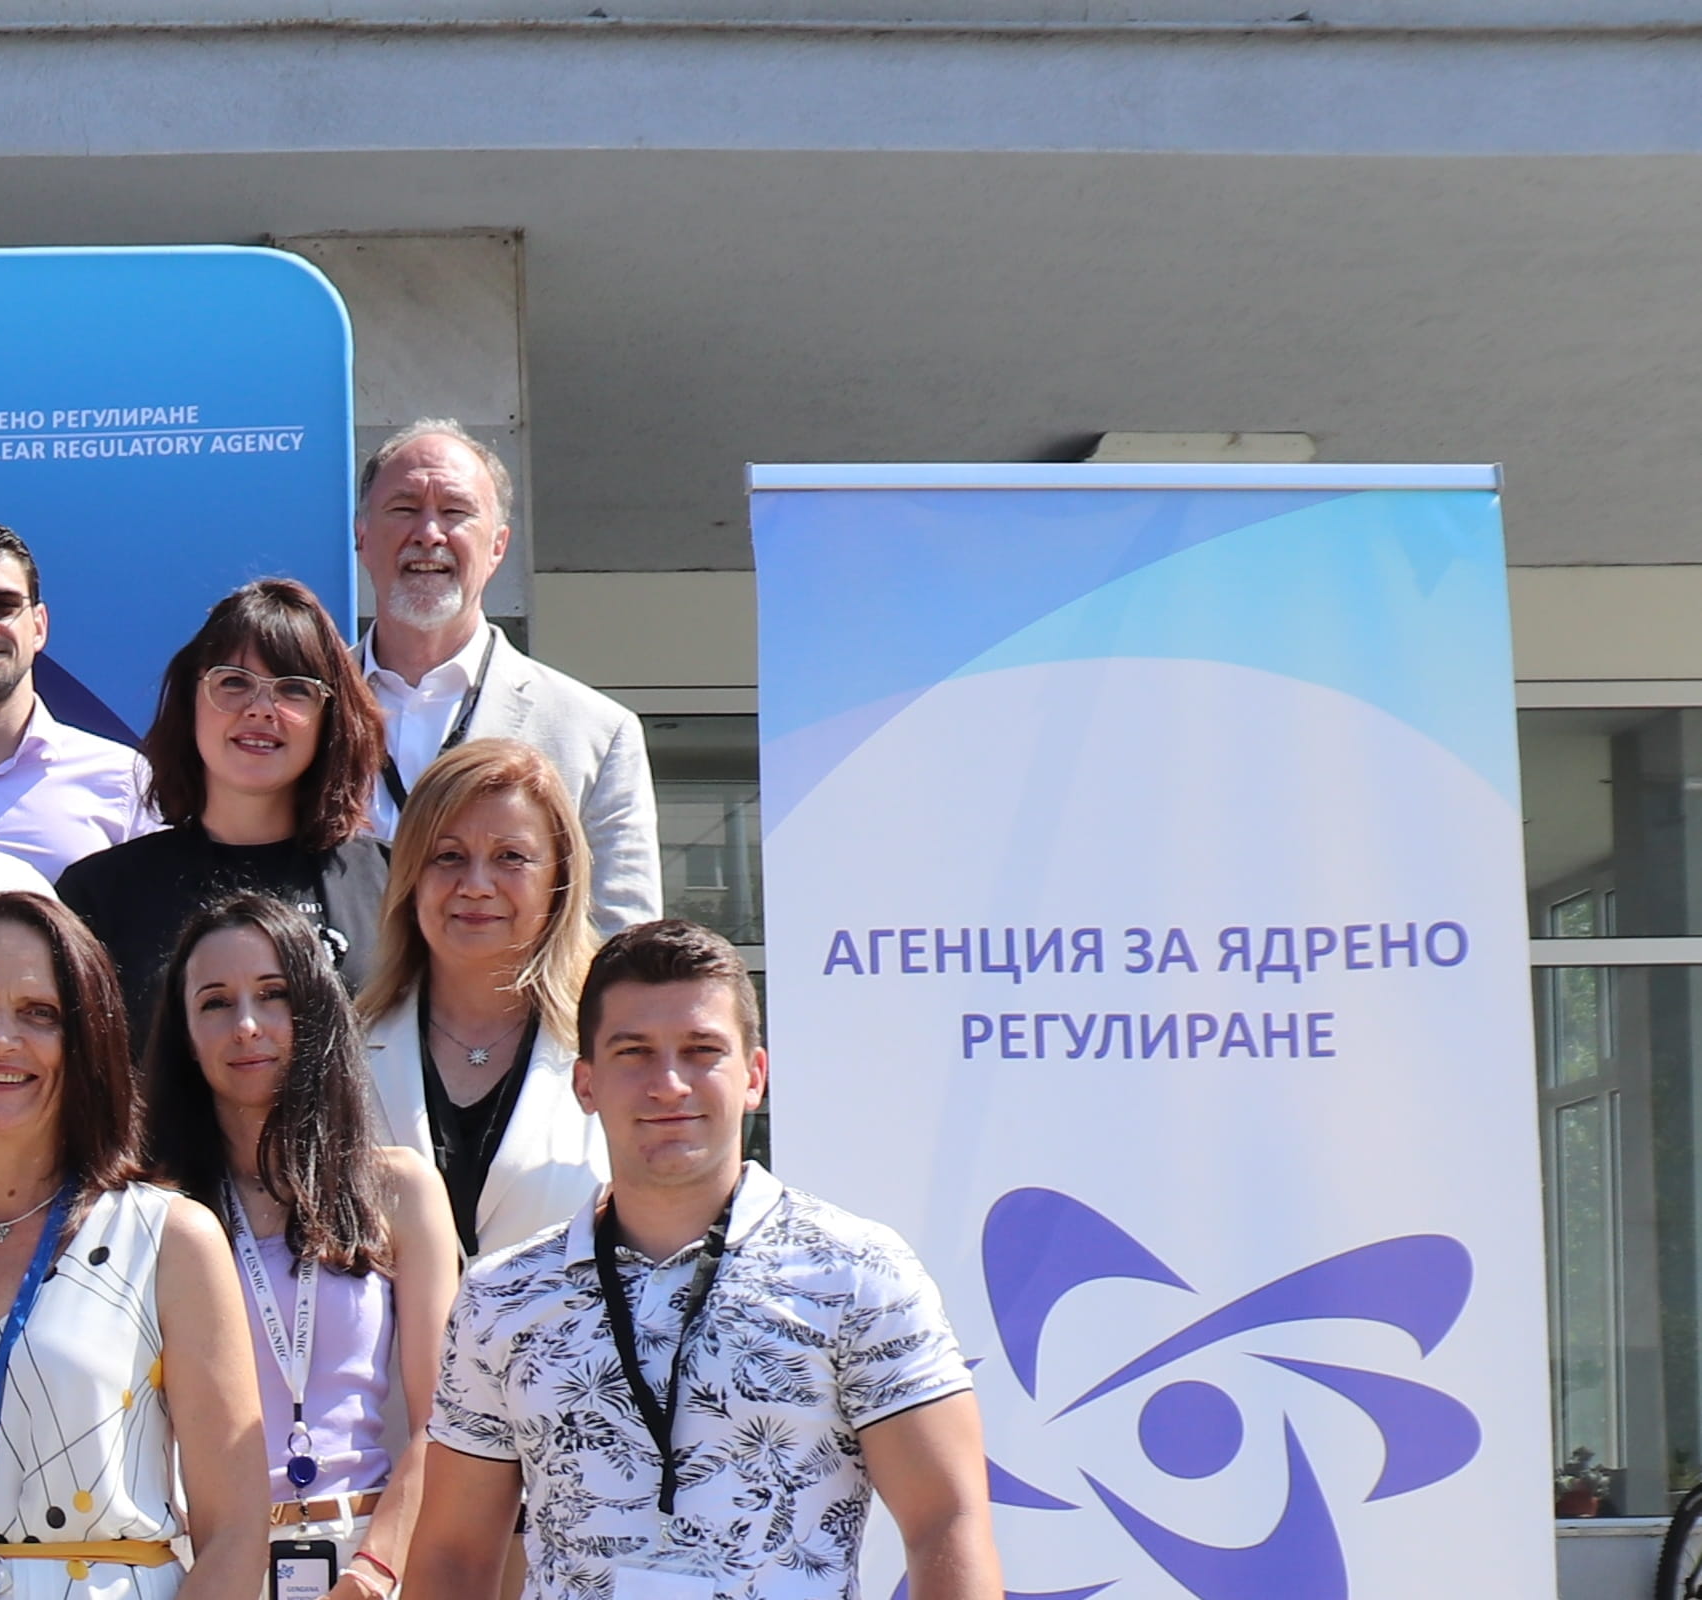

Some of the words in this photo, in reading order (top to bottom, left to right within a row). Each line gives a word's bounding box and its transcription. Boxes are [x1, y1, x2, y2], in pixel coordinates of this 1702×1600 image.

[52, 405, 200, 430] РЕГУЛИРАНЕ
[53, 434, 204, 460] REGULATORY
[210, 432, 305, 455] AGENCY
[822, 926, 1103, 984] АГЕНЦИЯ
[1124, 926, 1197, 974] ЗА
[1217, 920, 1470, 984] ЯДРЕНО
[961, 1011, 1336, 1060] РЕГУЛИРАНЕ
